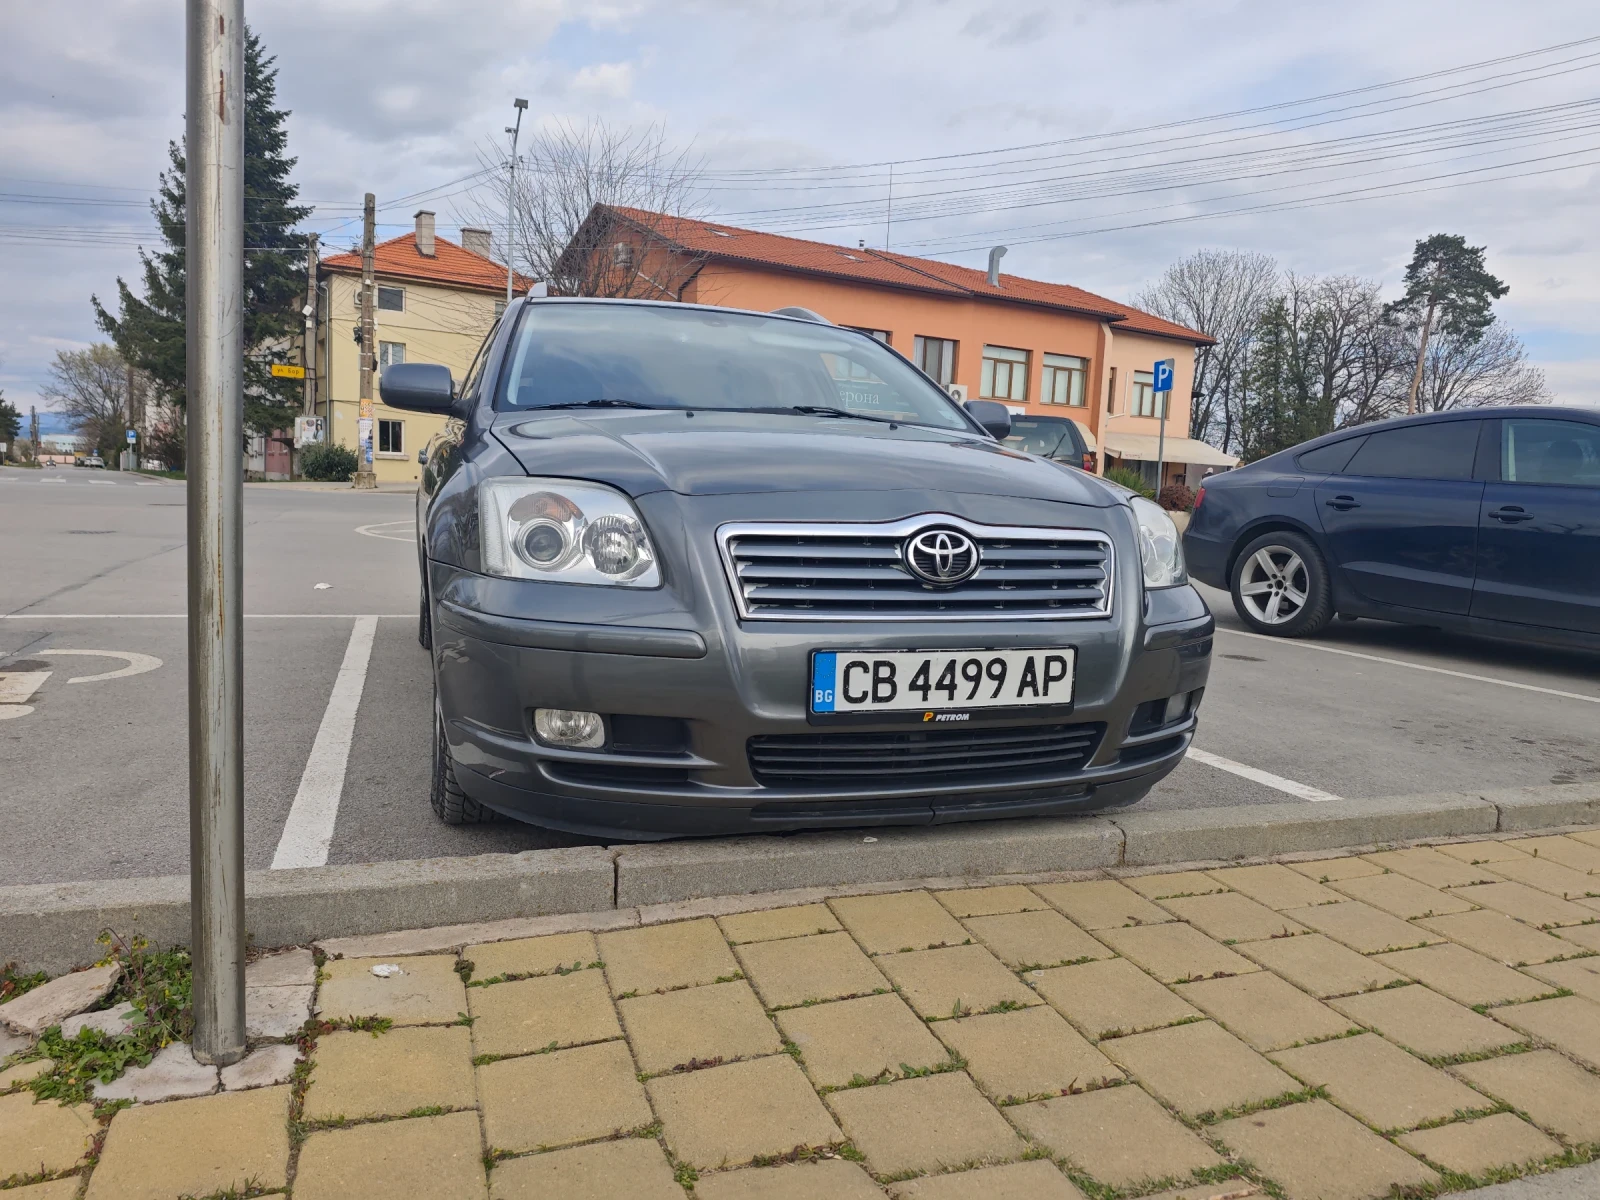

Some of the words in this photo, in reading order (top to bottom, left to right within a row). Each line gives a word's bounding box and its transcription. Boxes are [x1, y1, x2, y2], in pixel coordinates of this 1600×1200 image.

[1158, 364, 1170, 388] P
[839, 390, 880, 408] ерона
[842, 660, 898, 704] CB
[908, 658, 1008, 702] 4499
[1016, 655, 1068, 698] AP
[815, 689, 833, 703] BG
[935, 713, 970, 722] PETROM
